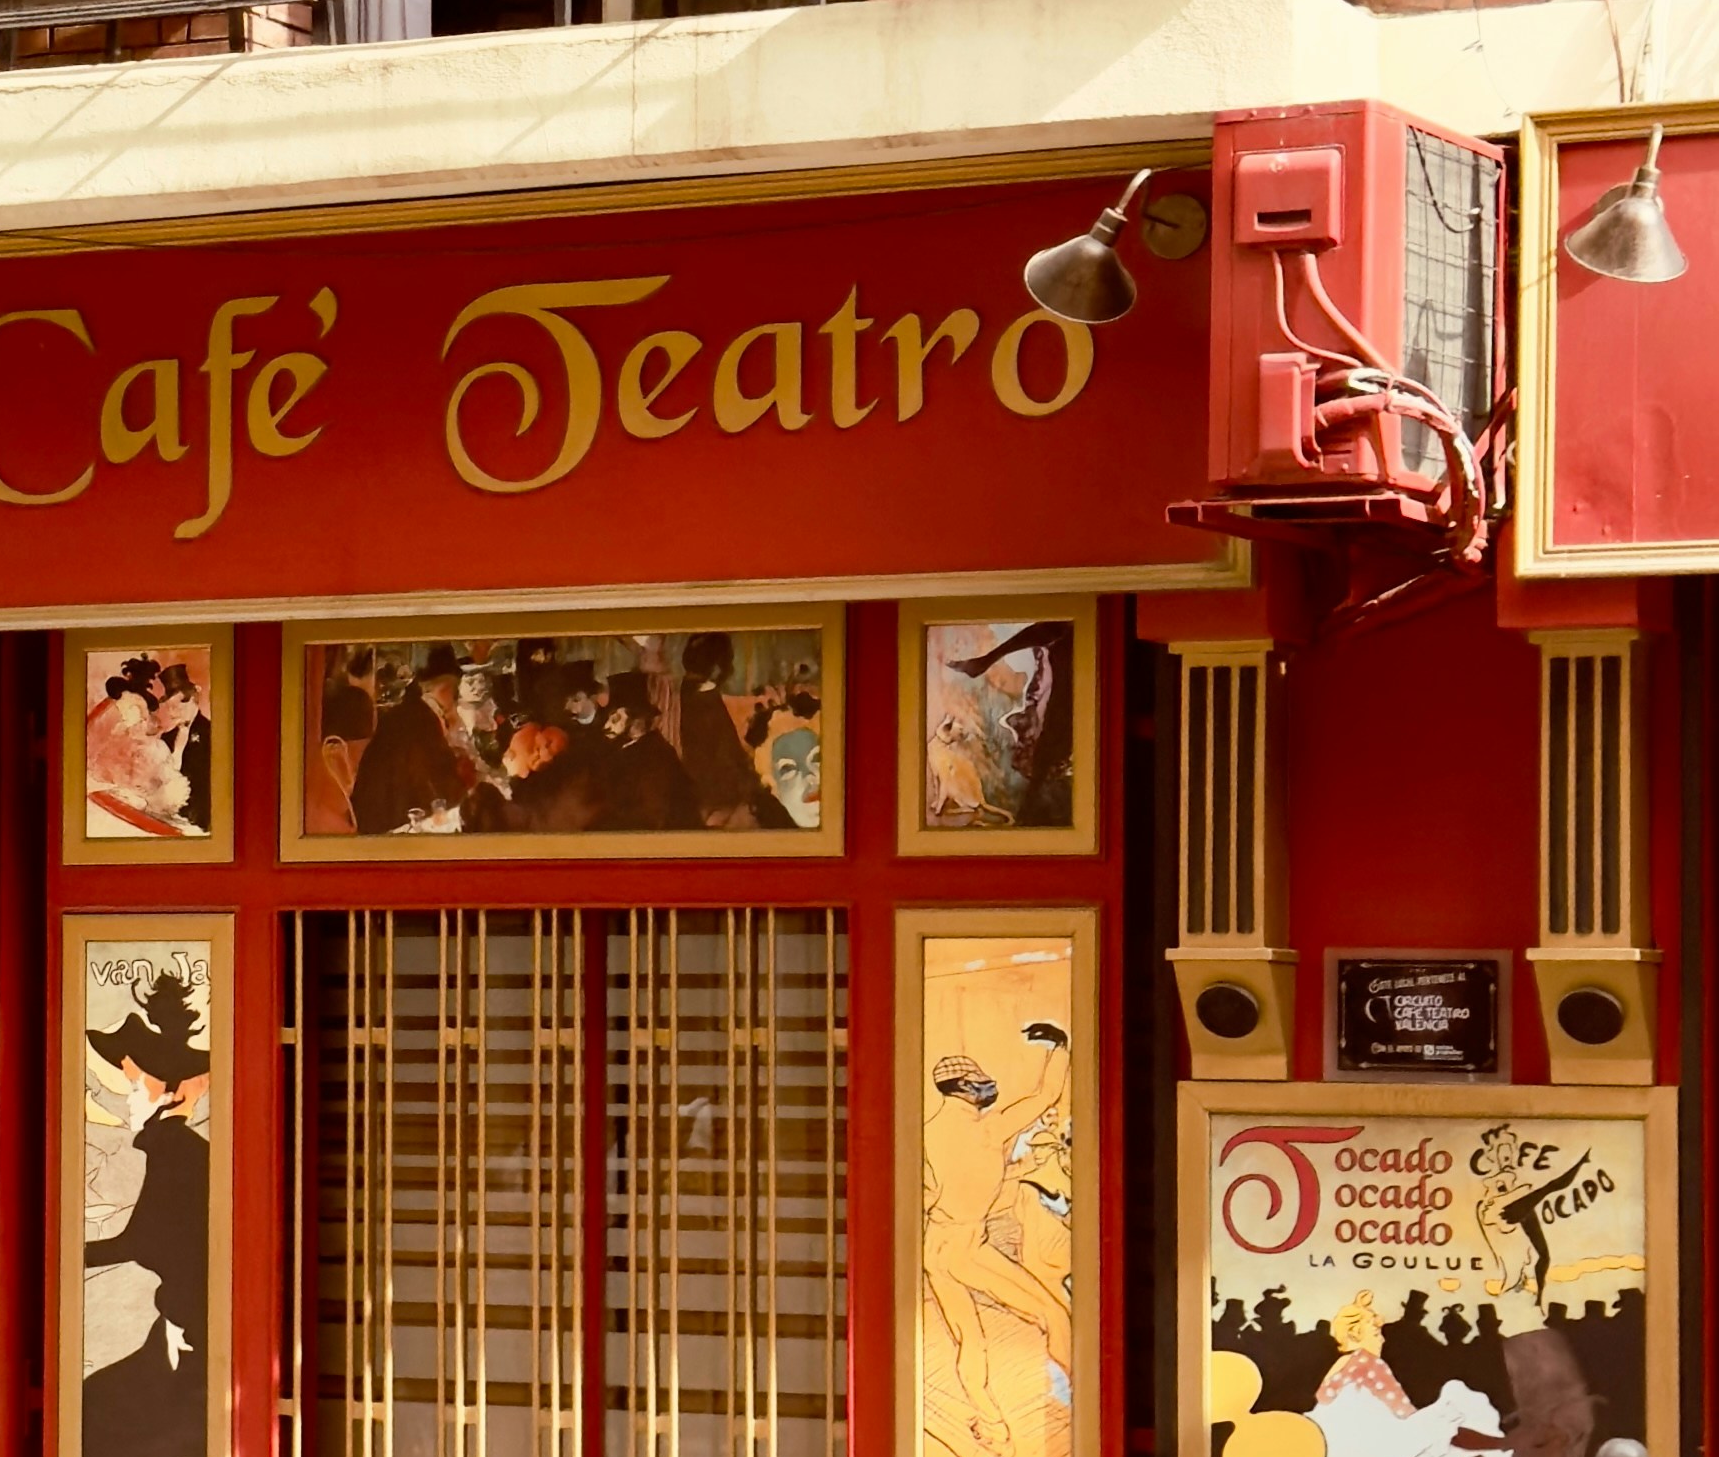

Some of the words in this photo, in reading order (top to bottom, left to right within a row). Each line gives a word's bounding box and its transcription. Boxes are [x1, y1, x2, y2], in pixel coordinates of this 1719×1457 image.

[441, 275, 1094, 494] Teatro
[1394, 995, 1443, 1007] CIRCUITO
[1309, 1253, 1336, 1269] LA
[1352, 1252, 1484, 1271] GOULUE
